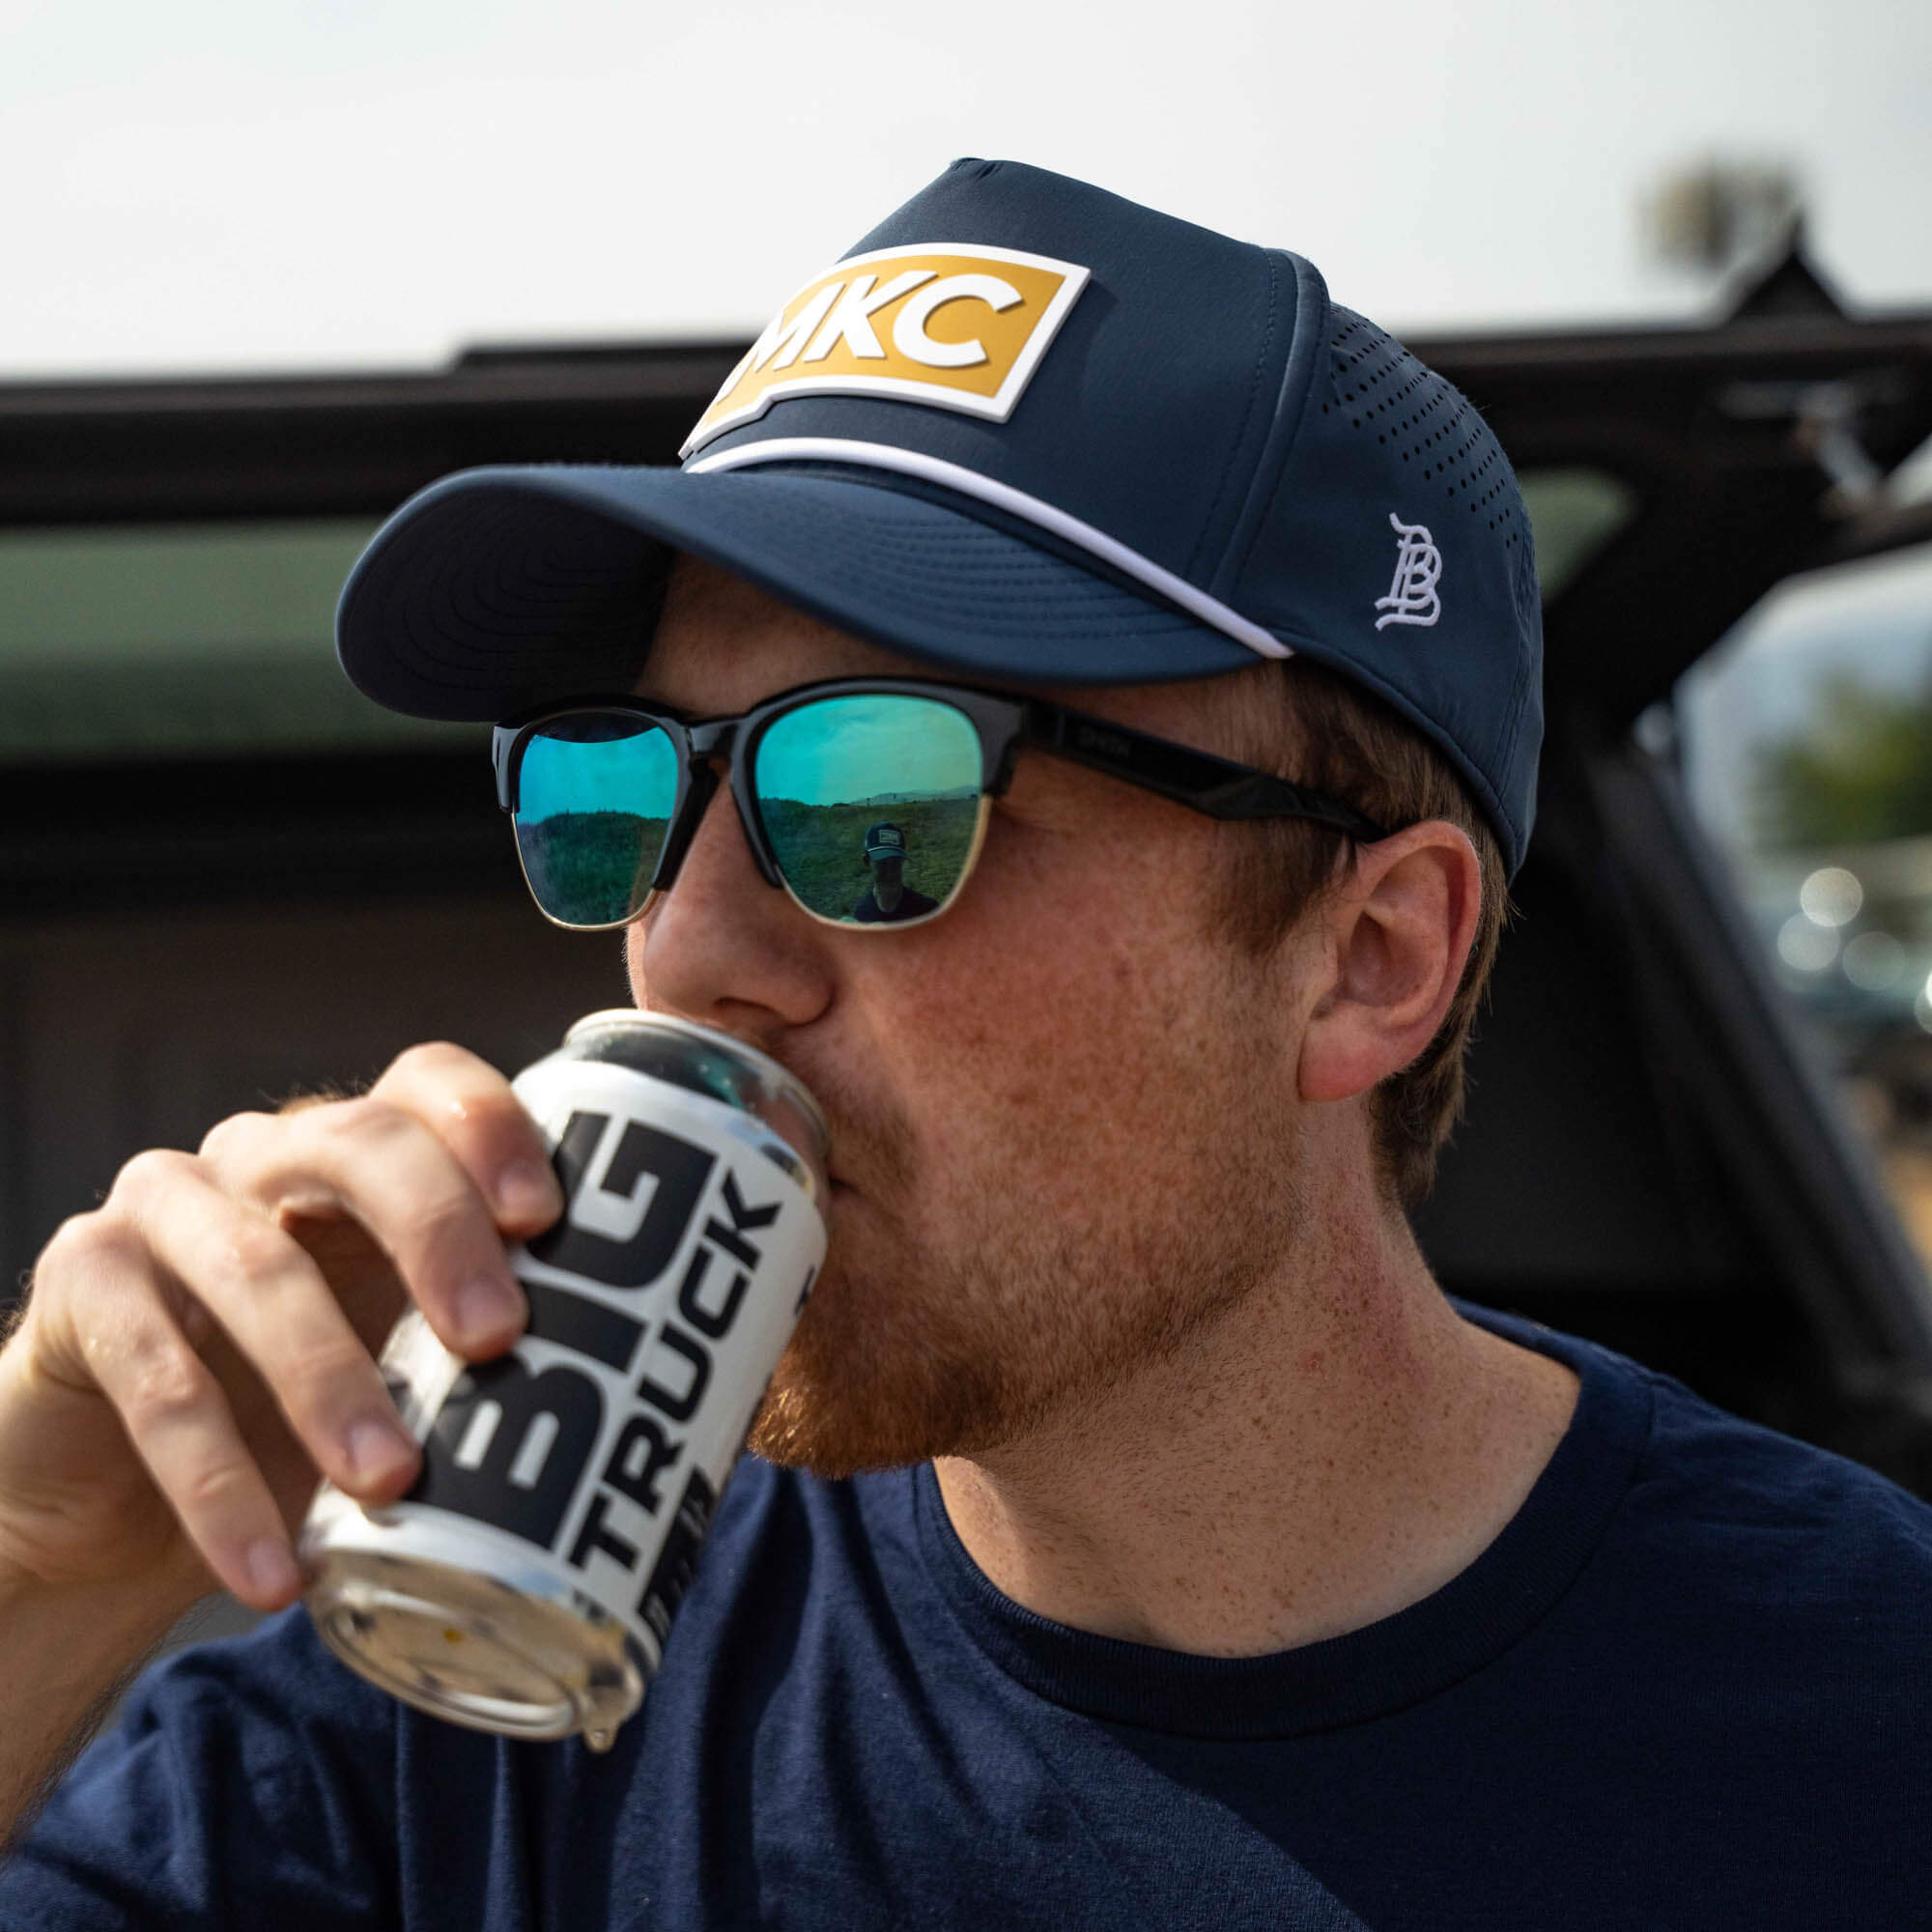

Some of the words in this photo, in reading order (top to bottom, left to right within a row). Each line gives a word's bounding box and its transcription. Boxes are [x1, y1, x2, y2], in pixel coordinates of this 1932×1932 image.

[715, 270, 1024, 405] MKC
[406, 1110, 720, 1548] BIG
[569, 1166, 784, 1581] TRUCK
